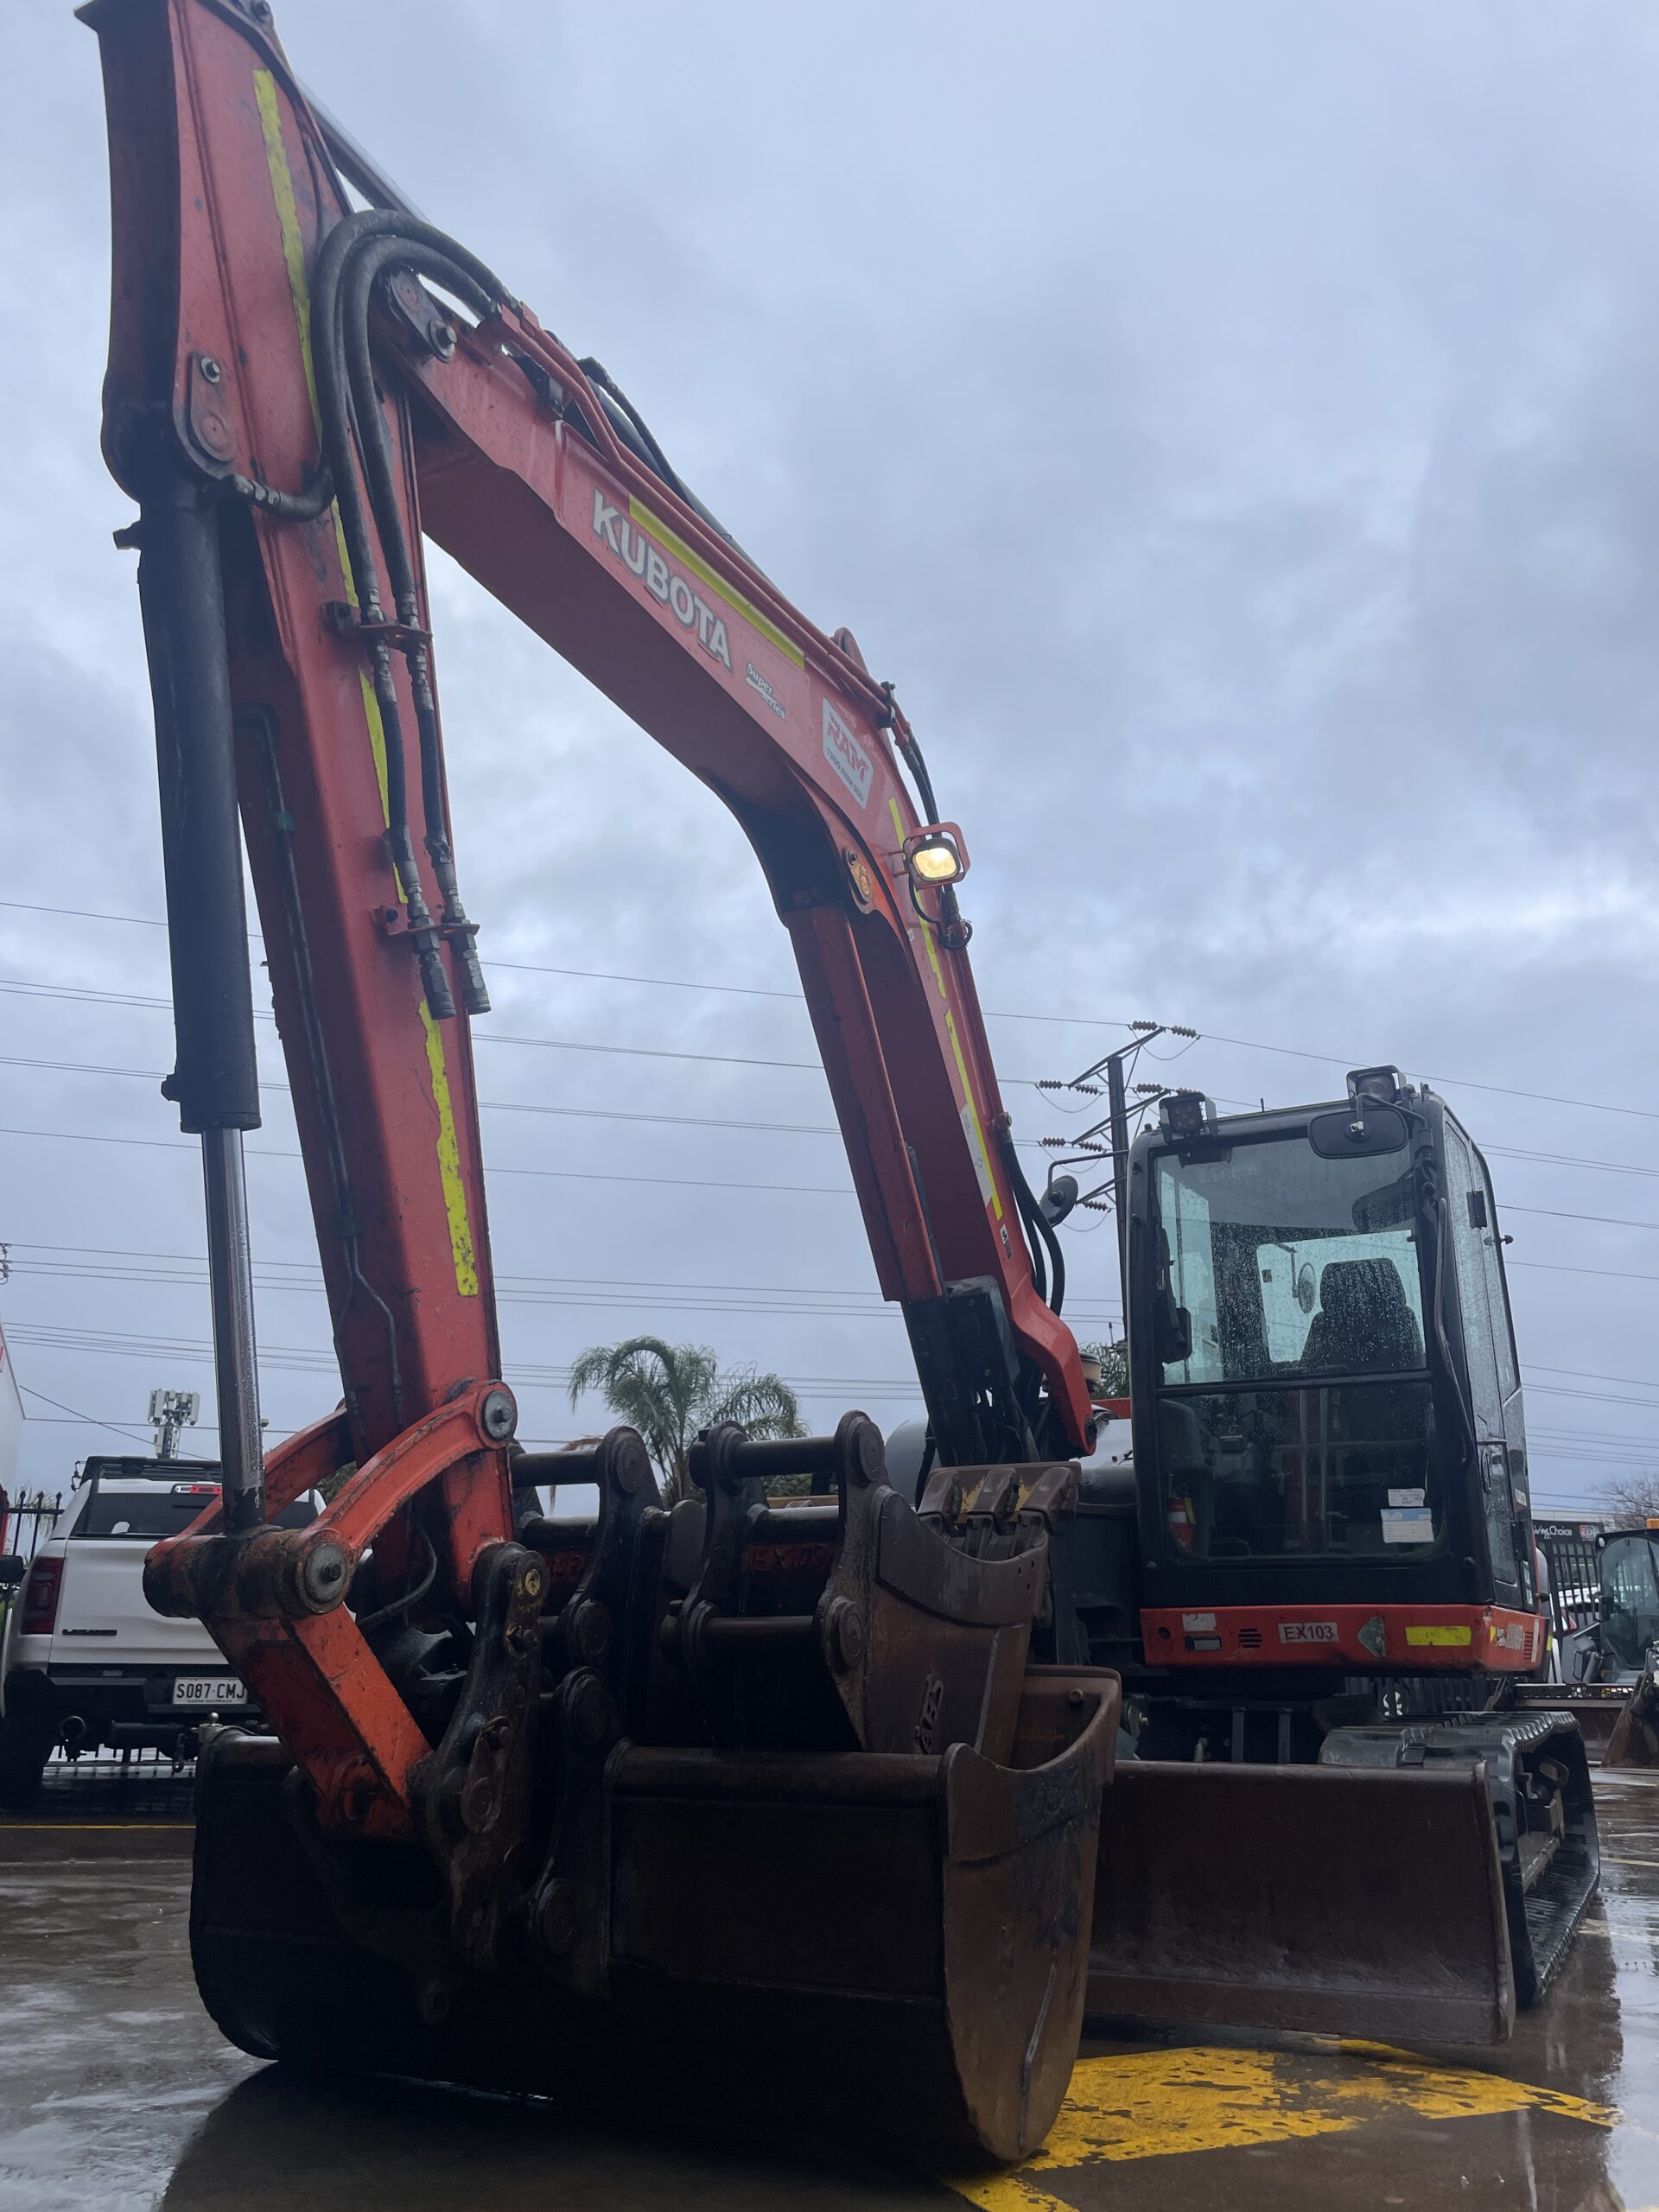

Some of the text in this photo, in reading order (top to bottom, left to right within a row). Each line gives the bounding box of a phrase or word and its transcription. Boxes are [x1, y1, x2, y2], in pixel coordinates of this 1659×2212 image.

[594, 488, 733, 673] KUBOTA
[747, 663, 774, 696] Super
[1283, 1625, 1334, 1640] EX103
